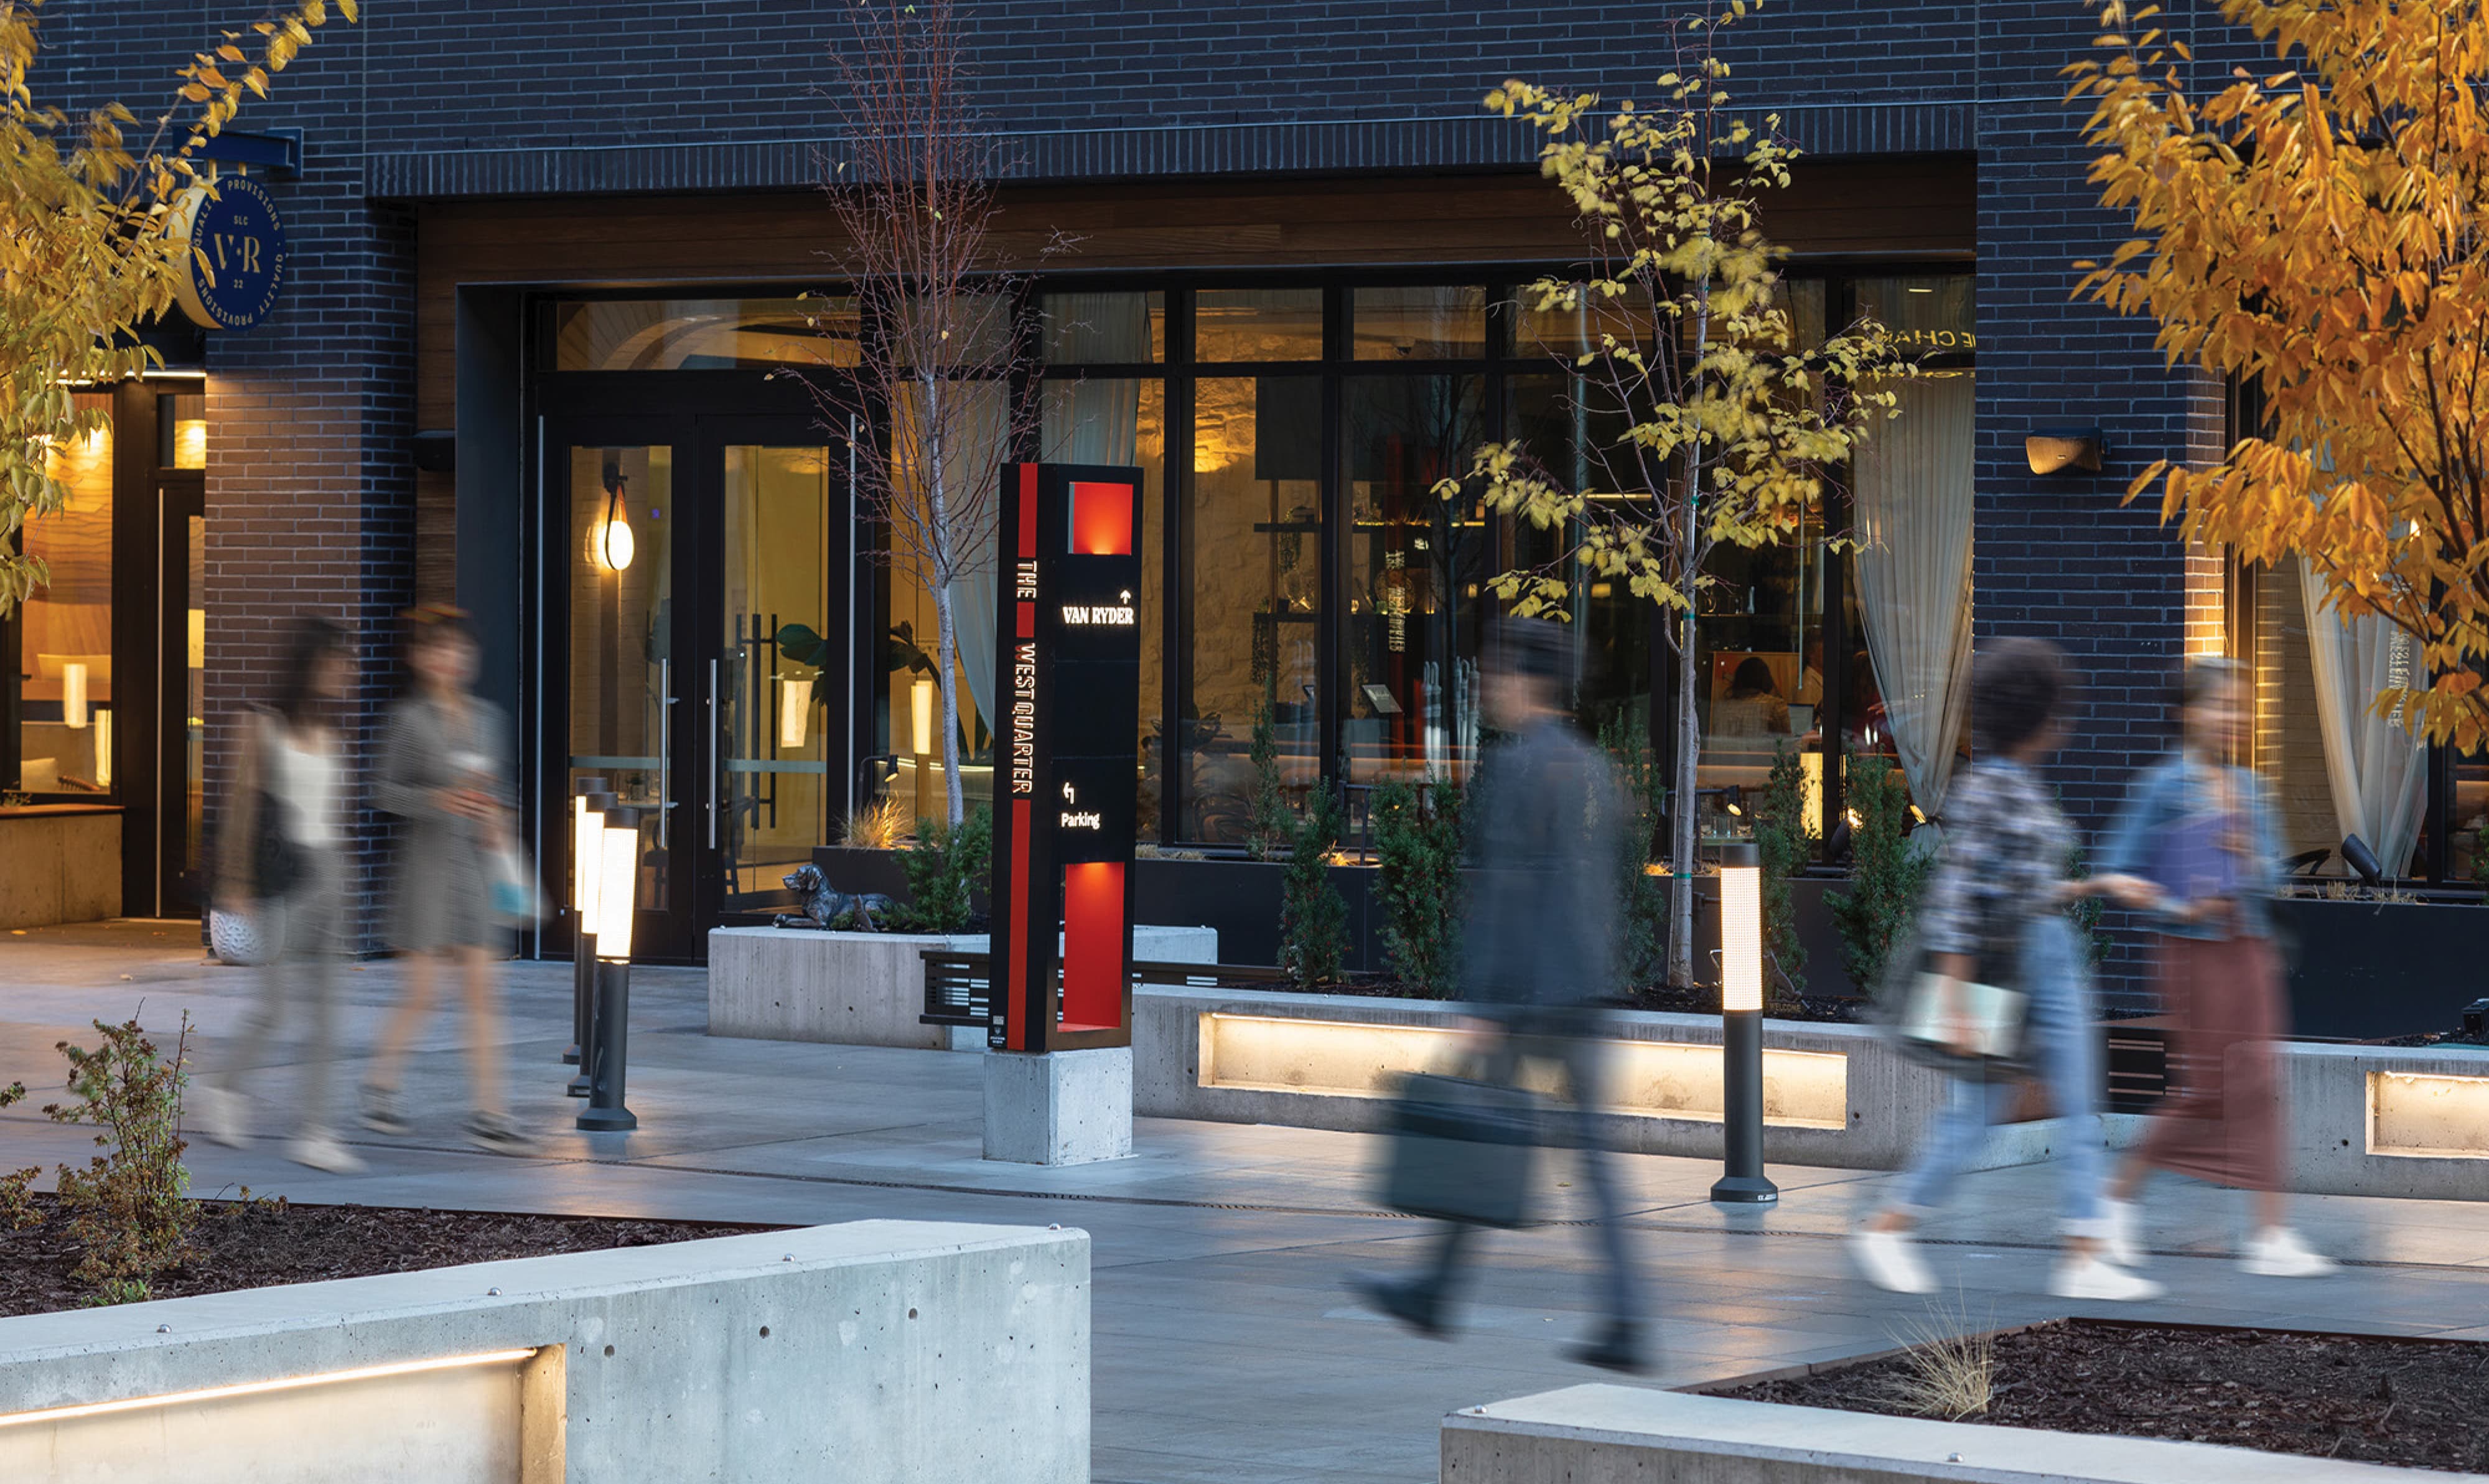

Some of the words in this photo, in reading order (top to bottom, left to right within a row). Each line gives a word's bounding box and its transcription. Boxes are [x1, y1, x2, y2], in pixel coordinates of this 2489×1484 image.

[194, 186, 220, 246] QUALI
[228, 179, 280, 231] PROVISIONS
[233, 215, 248, 225] SLC
[233, 278, 243, 289] 22
[259, 253, 283, 315] QUALITY
[198, 278, 253, 326] PROVISIONS
[1017, 561, 1037, 599] THE
[1063, 606, 1090, 623] VAN
[1091, 606, 1134, 624] RYDER
[1061, 811, 1101, 829] Parking
